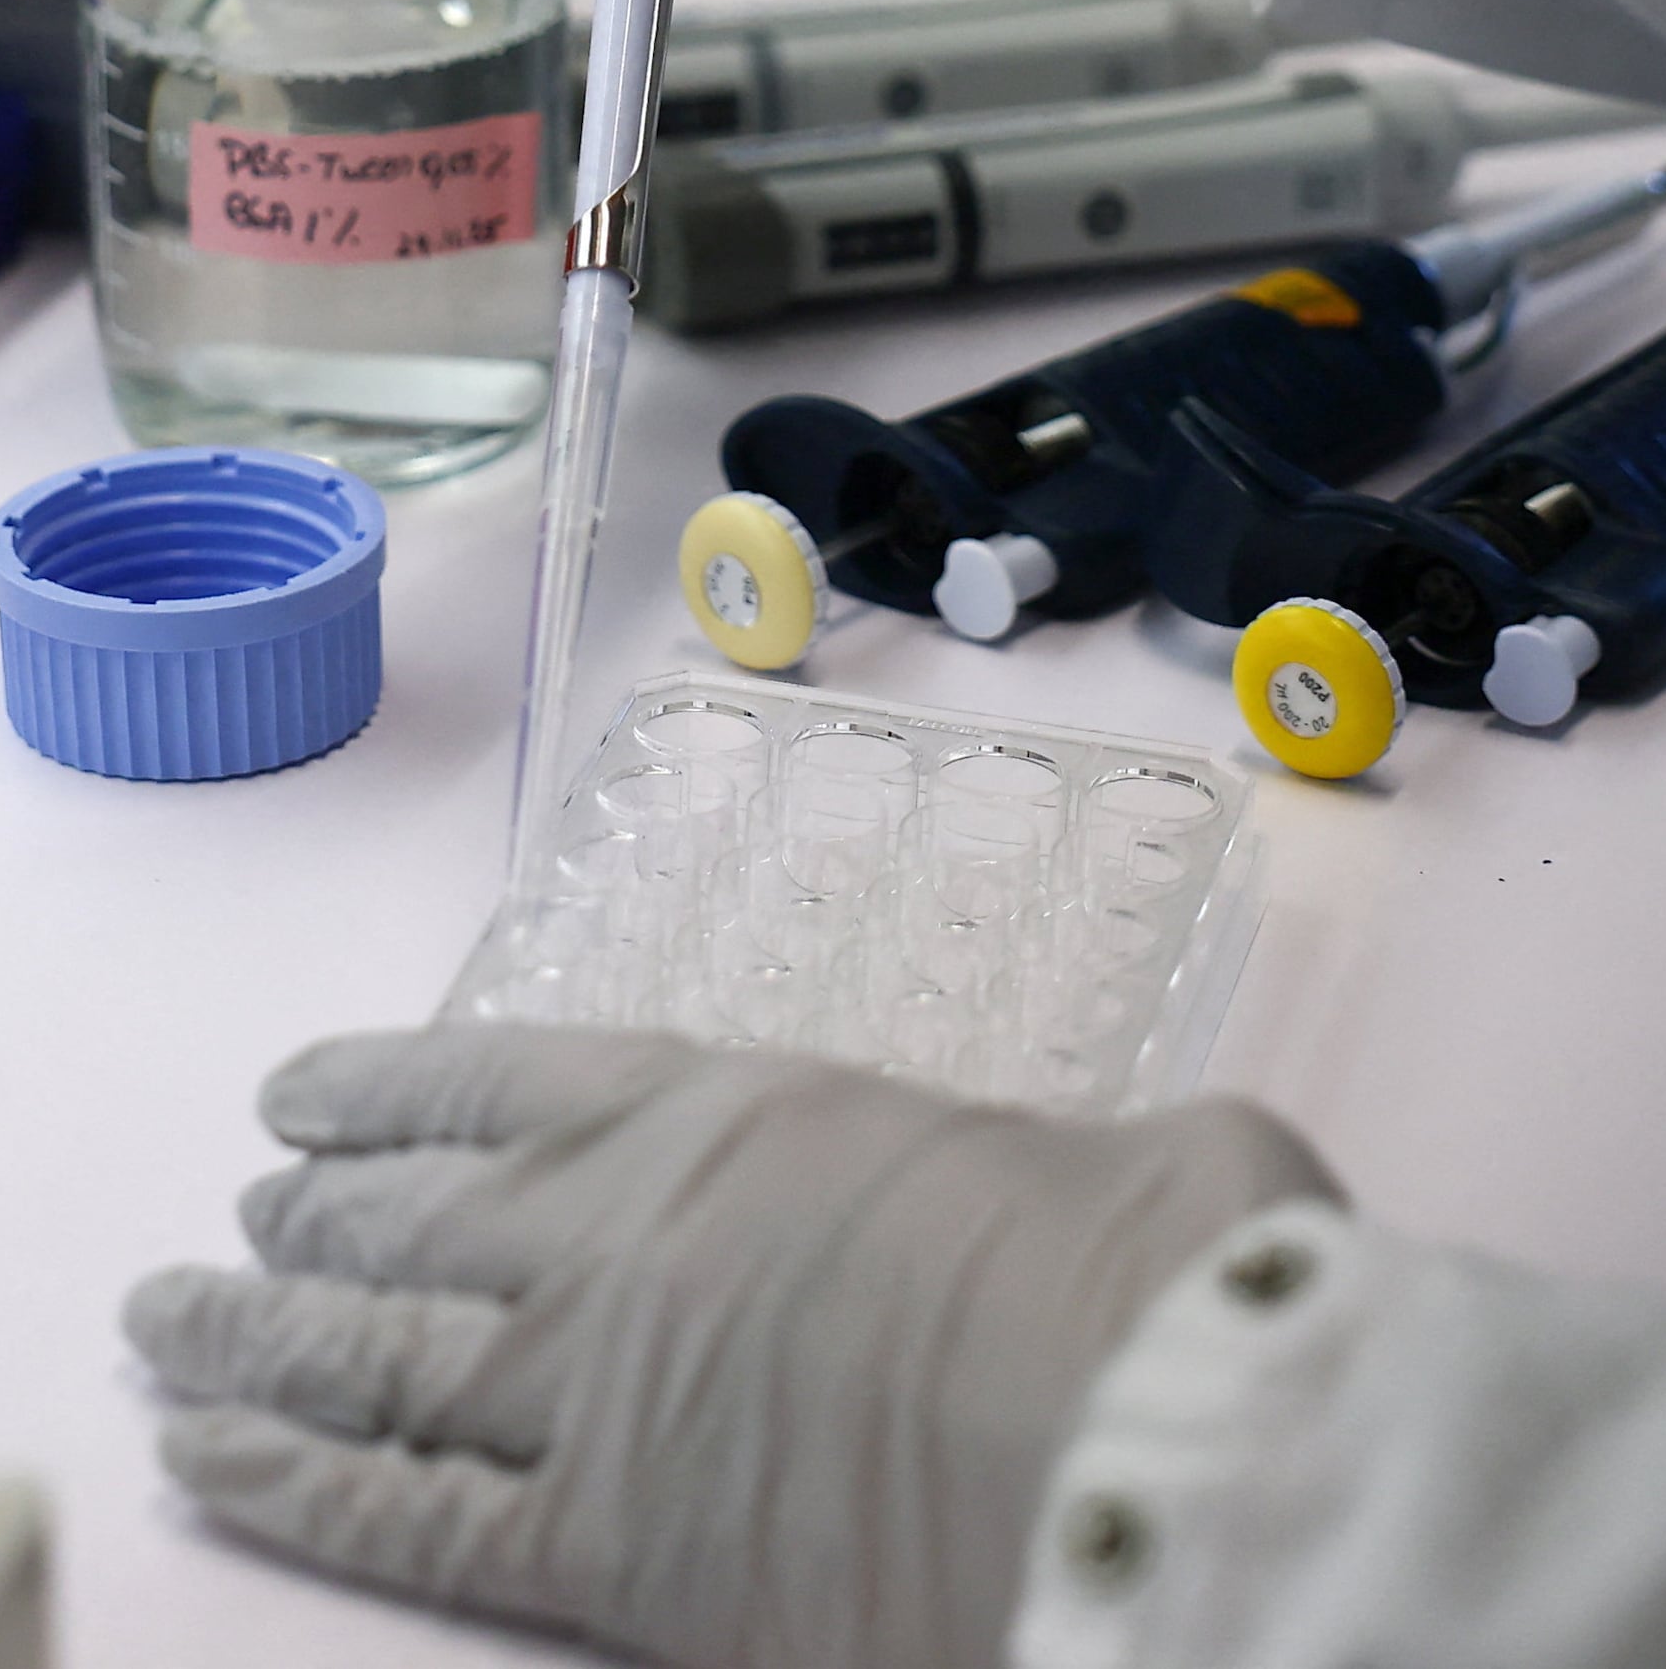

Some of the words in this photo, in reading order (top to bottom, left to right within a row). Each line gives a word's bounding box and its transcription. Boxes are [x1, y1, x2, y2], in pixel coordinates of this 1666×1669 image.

[1298, 672, 1331, 703] P200
[1277, 702, 1301, 728] 200
[1312, 715, 1330, 732] 20
